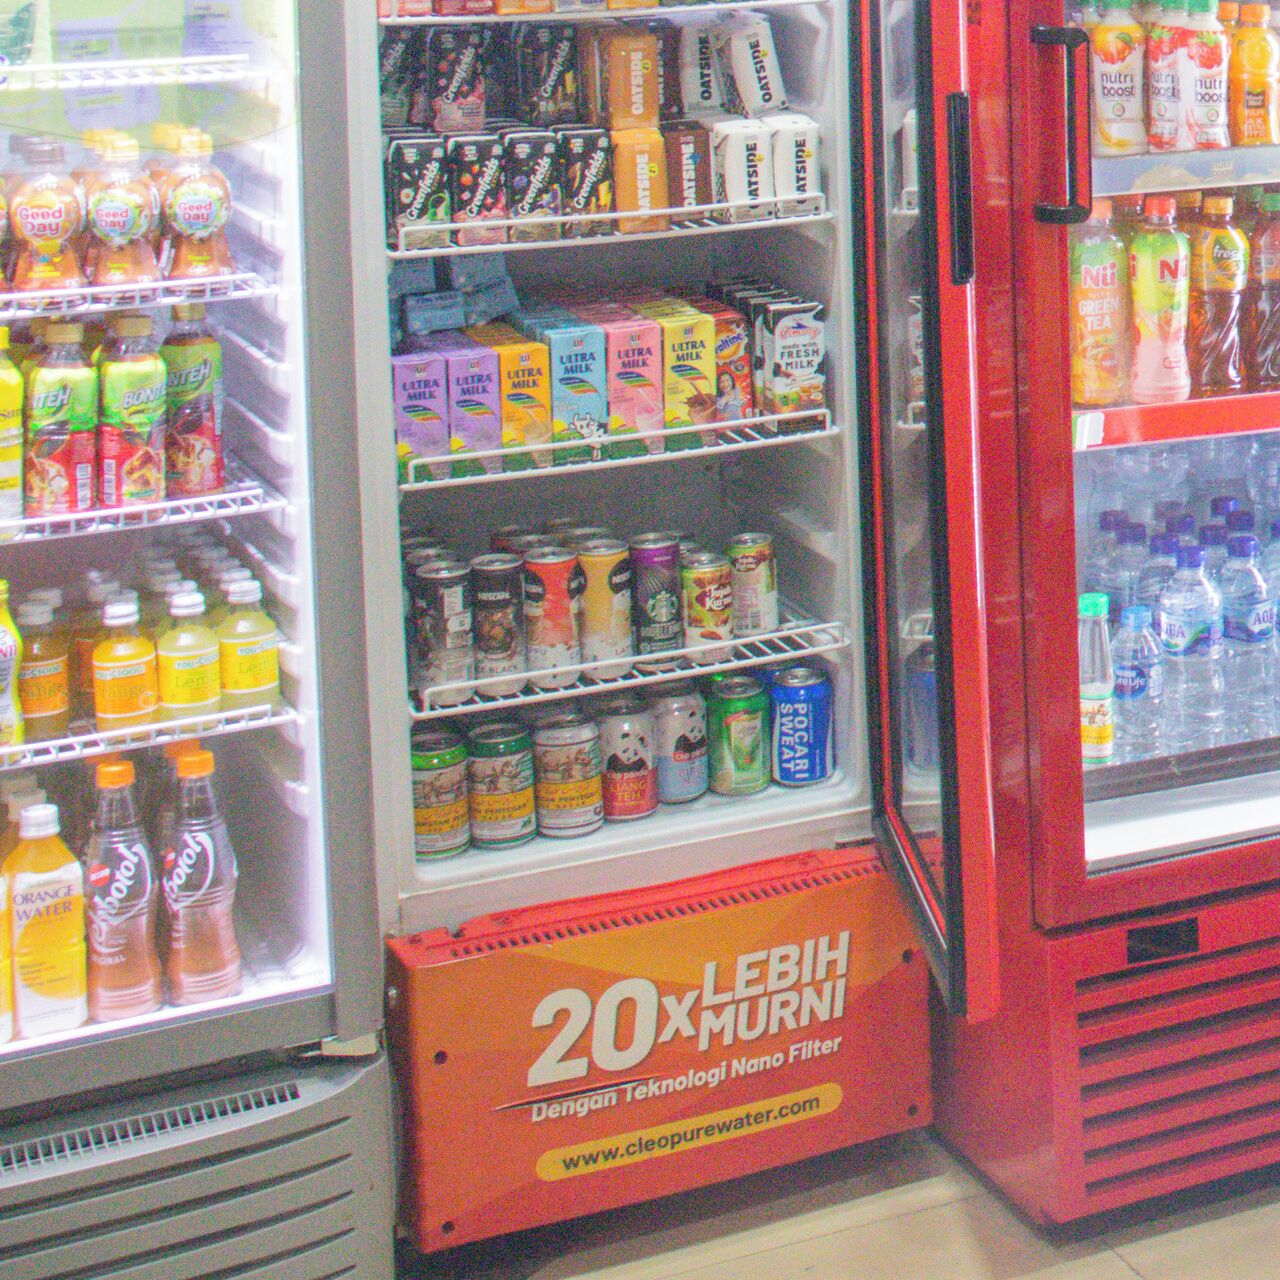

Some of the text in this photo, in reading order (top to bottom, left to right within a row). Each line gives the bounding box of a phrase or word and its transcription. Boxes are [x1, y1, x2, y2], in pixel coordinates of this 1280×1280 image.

[750, 38, 773, 104] OATSIDE
[1101, 72, 1134, 84] nutri
[630, 48, 643, 116] OATSIDE
[1102, 85, 1135, 97] boost
[406, 159, 441, 221] Greenfields
[466, 158, 499, 218] Greenfields
[19, 206, 63, 222] Good
[95, 207, 129, 221] Good
[178, 201, 213, 214] Good
[100, 218, 126, 232] Day
[182, 211, 210, 223] Day
[23, 220, 60, 236] Day
[1078, 297, 1119, 316] GREEN
[1085, 312, 1112, 332] TEA
[779, 349, 820, 360] FRESH
[506, 367, 543, 381] ULTRA
[564, 362, 593, 375] MILK
[401, 377, 440, 390] ULTRA
[455, 373, 493, 387] ULTRA
[510, 376, 540, 389] MILK
[406, 388, 437, 401] MILK
[460, 383, 489, 396] MILK
[779, 701, 795, 775] SWEAT
[793, 699, 811, 781] POCARI
[13, 884, 75, 906] ORANGE
[16, 901, 73, 920] WATER
[701, 930, 851, 1008] LEBIH
[698, 975, 847, 1052] MURNI
[526, 976, 700, 1088] 20x
[531, 1035, 842, 1123] Dengan Teknologi Nano Filter
[561, 1092, 821, 1172] www.cleopurewater.com
